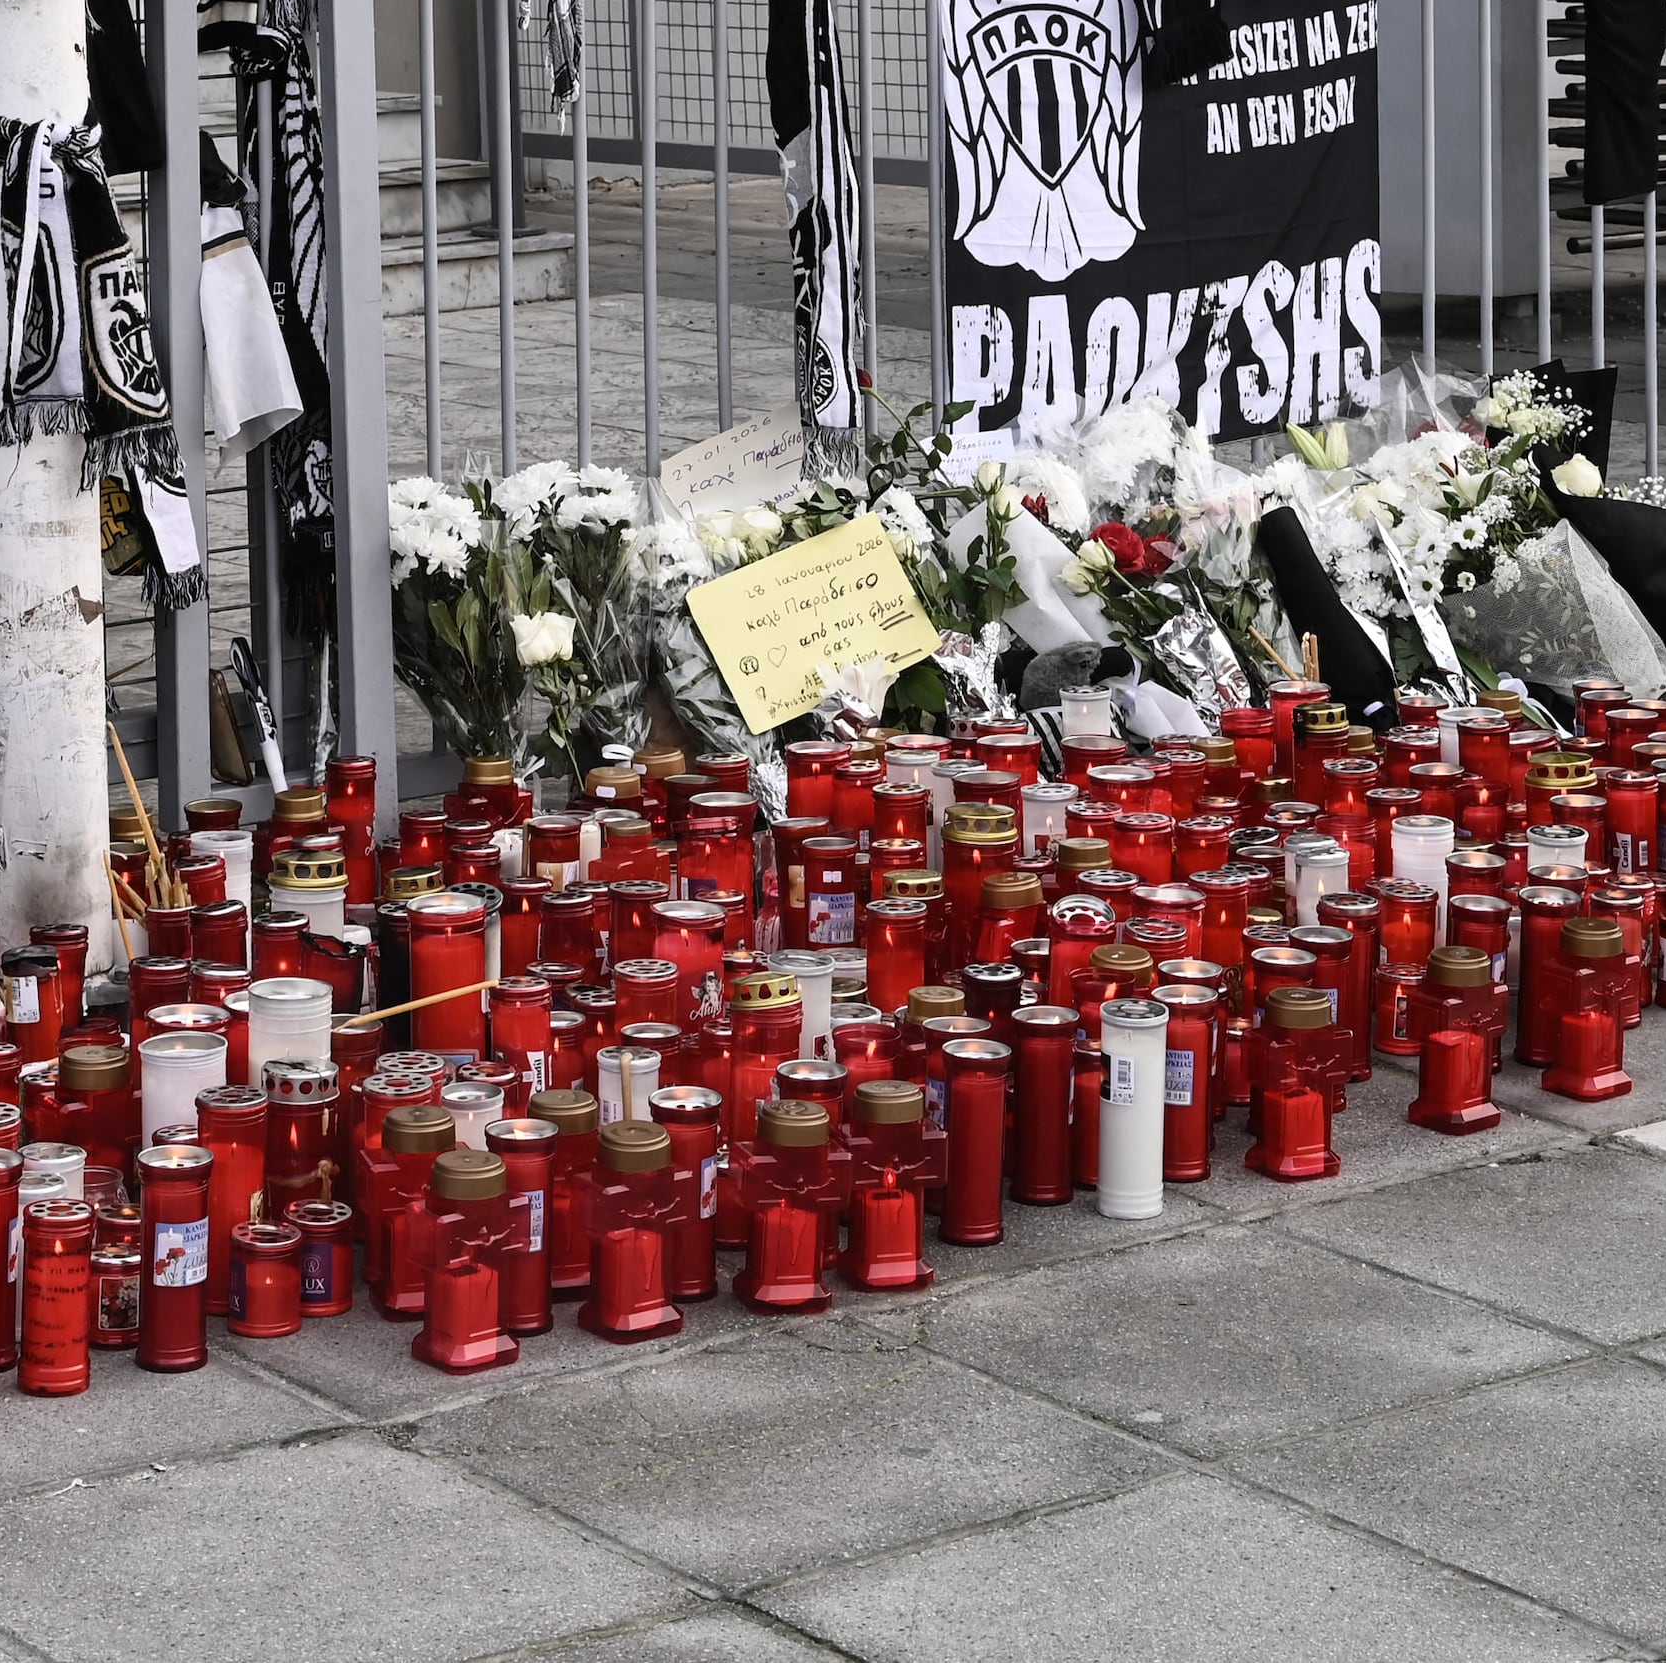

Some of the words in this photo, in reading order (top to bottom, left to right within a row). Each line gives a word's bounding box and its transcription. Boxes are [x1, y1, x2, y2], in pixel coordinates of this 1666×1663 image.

[982, 13, 1101, 63] ΠΑΟΚ
[1305, 12, 1344, 68] NA
[1207, 101, 1241, 156] AN
[1247, 89, 1297, 148] DEN
[856, 535, 885, 559] 2026
[1620, 839, 1630, 869] Candil
[533, 1058, 543, 1093] Candil
